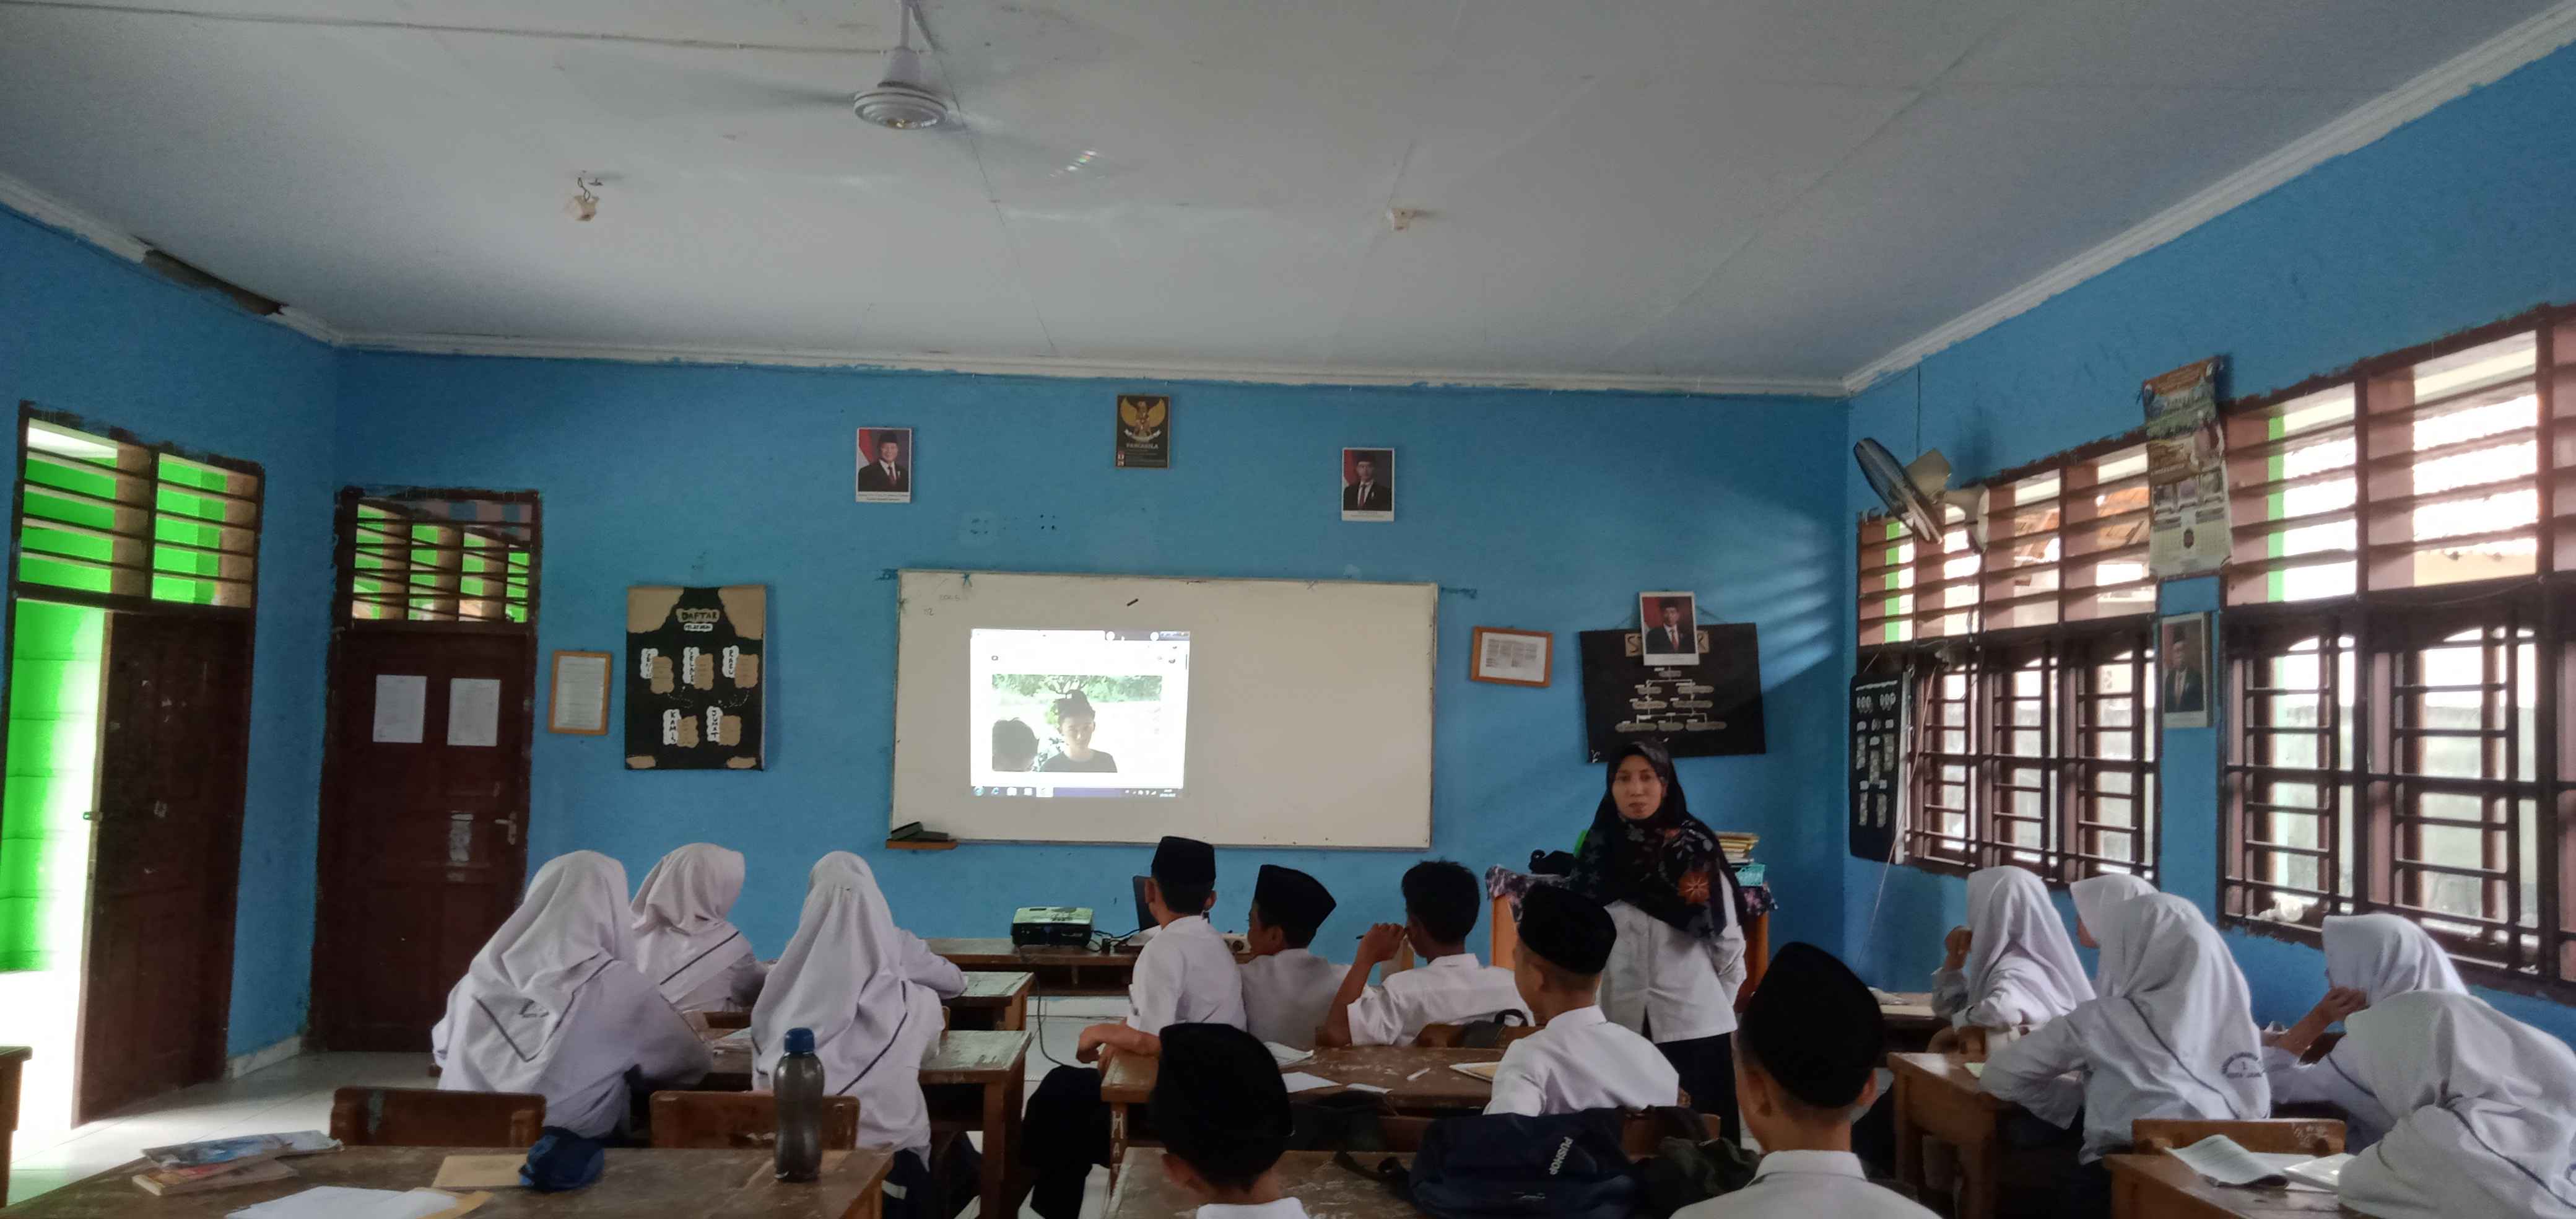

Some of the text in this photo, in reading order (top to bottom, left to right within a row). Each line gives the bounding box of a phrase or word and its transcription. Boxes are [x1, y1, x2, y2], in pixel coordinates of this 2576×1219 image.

[682, 611, 717, 621] DAFTAR
[711, 710, 719, 739] JUMAT
[1549, 1136, 1574, 1175] PUSHOP
